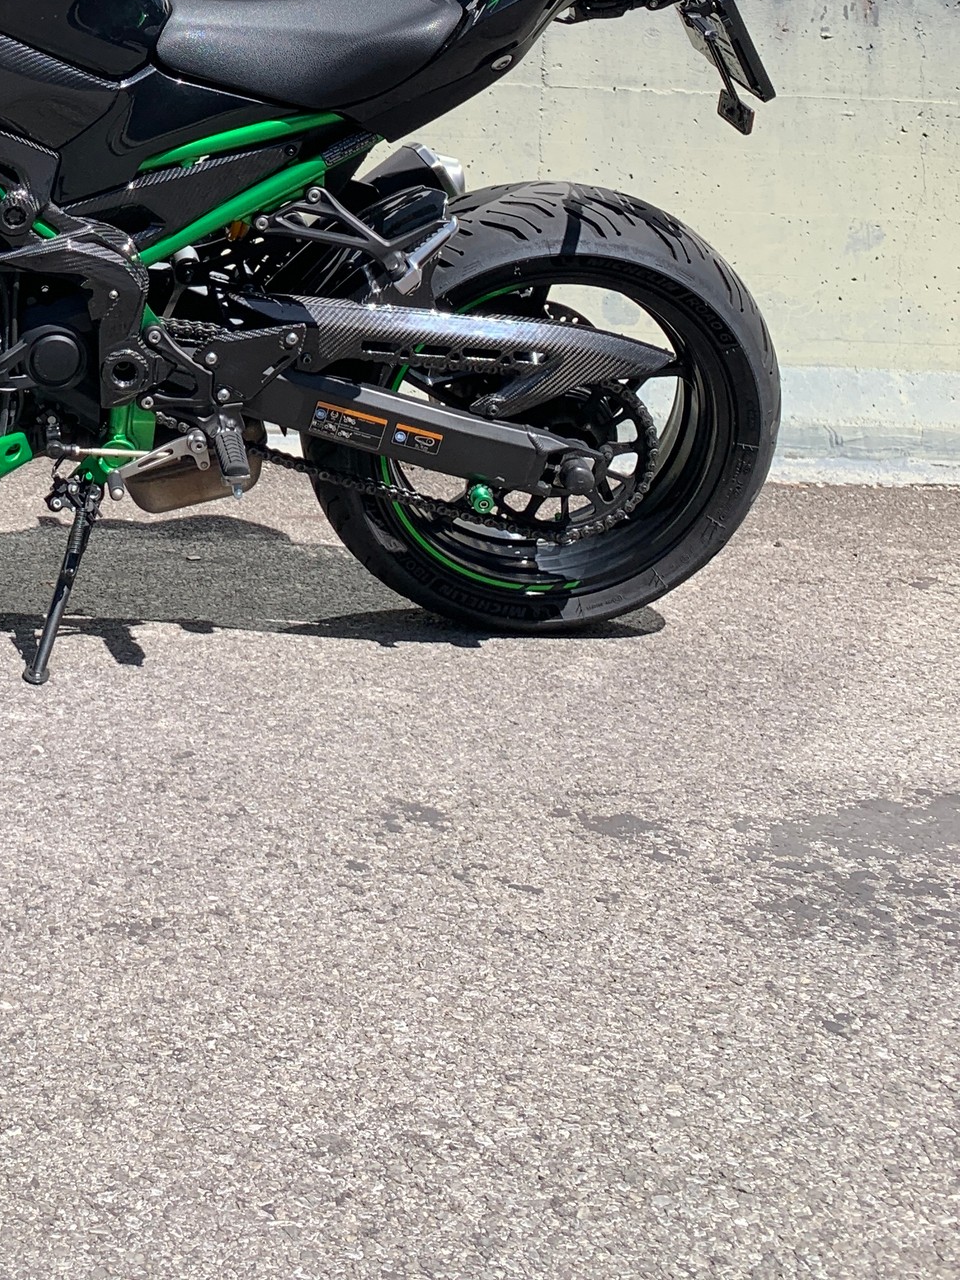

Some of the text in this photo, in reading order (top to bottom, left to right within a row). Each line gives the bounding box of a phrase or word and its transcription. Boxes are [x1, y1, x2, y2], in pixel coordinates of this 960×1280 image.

[589, 258, 681, 294] MICHELIN
[686, 294, 724, 333] ROAD
[438, 583, 527, 619] MICHELIN
